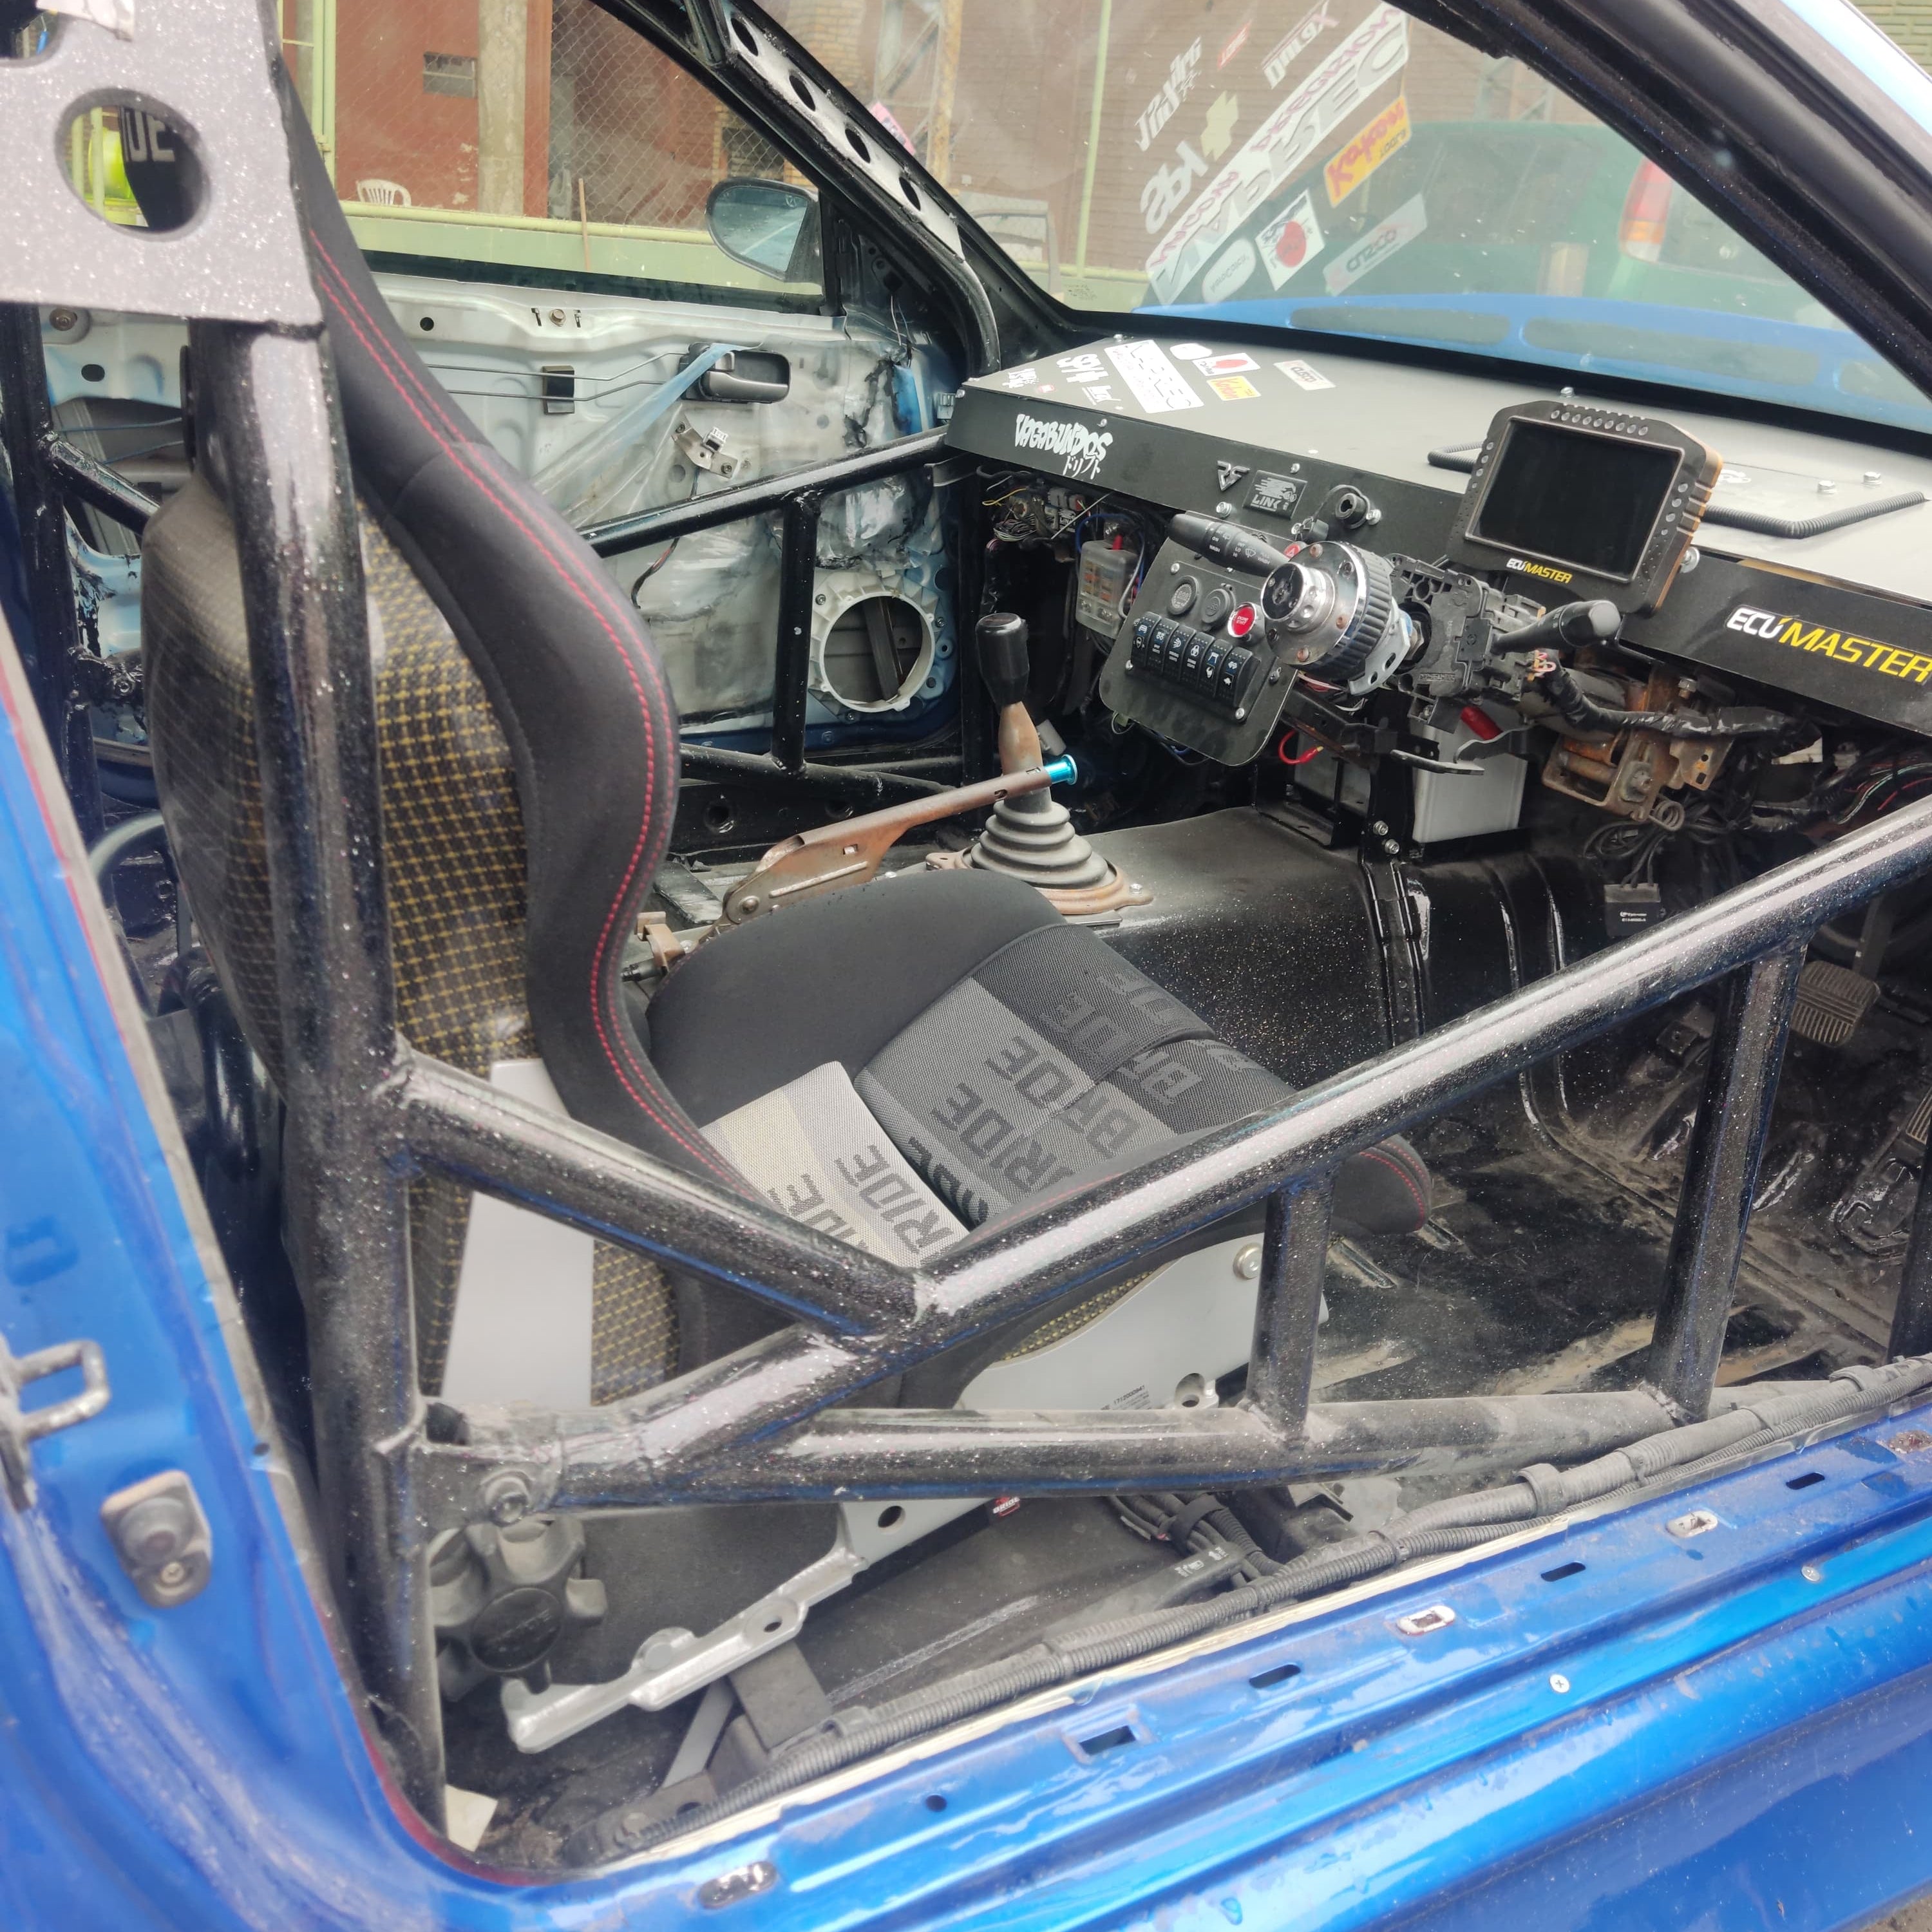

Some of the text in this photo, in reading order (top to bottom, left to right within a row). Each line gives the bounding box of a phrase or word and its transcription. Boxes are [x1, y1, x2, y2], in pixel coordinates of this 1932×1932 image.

[1015, 413, 1113, 461] VAGABUNDOS
[1063, 455, 1101, 480] ドリフト
[1250, 494, 1282, 509] LINK
[1506, 558, 1573, 583] ECUMASTER
[1727, 607, 1932, 683] ECUMASTER
[992, 1497, 1020, 1513] BRIDE
